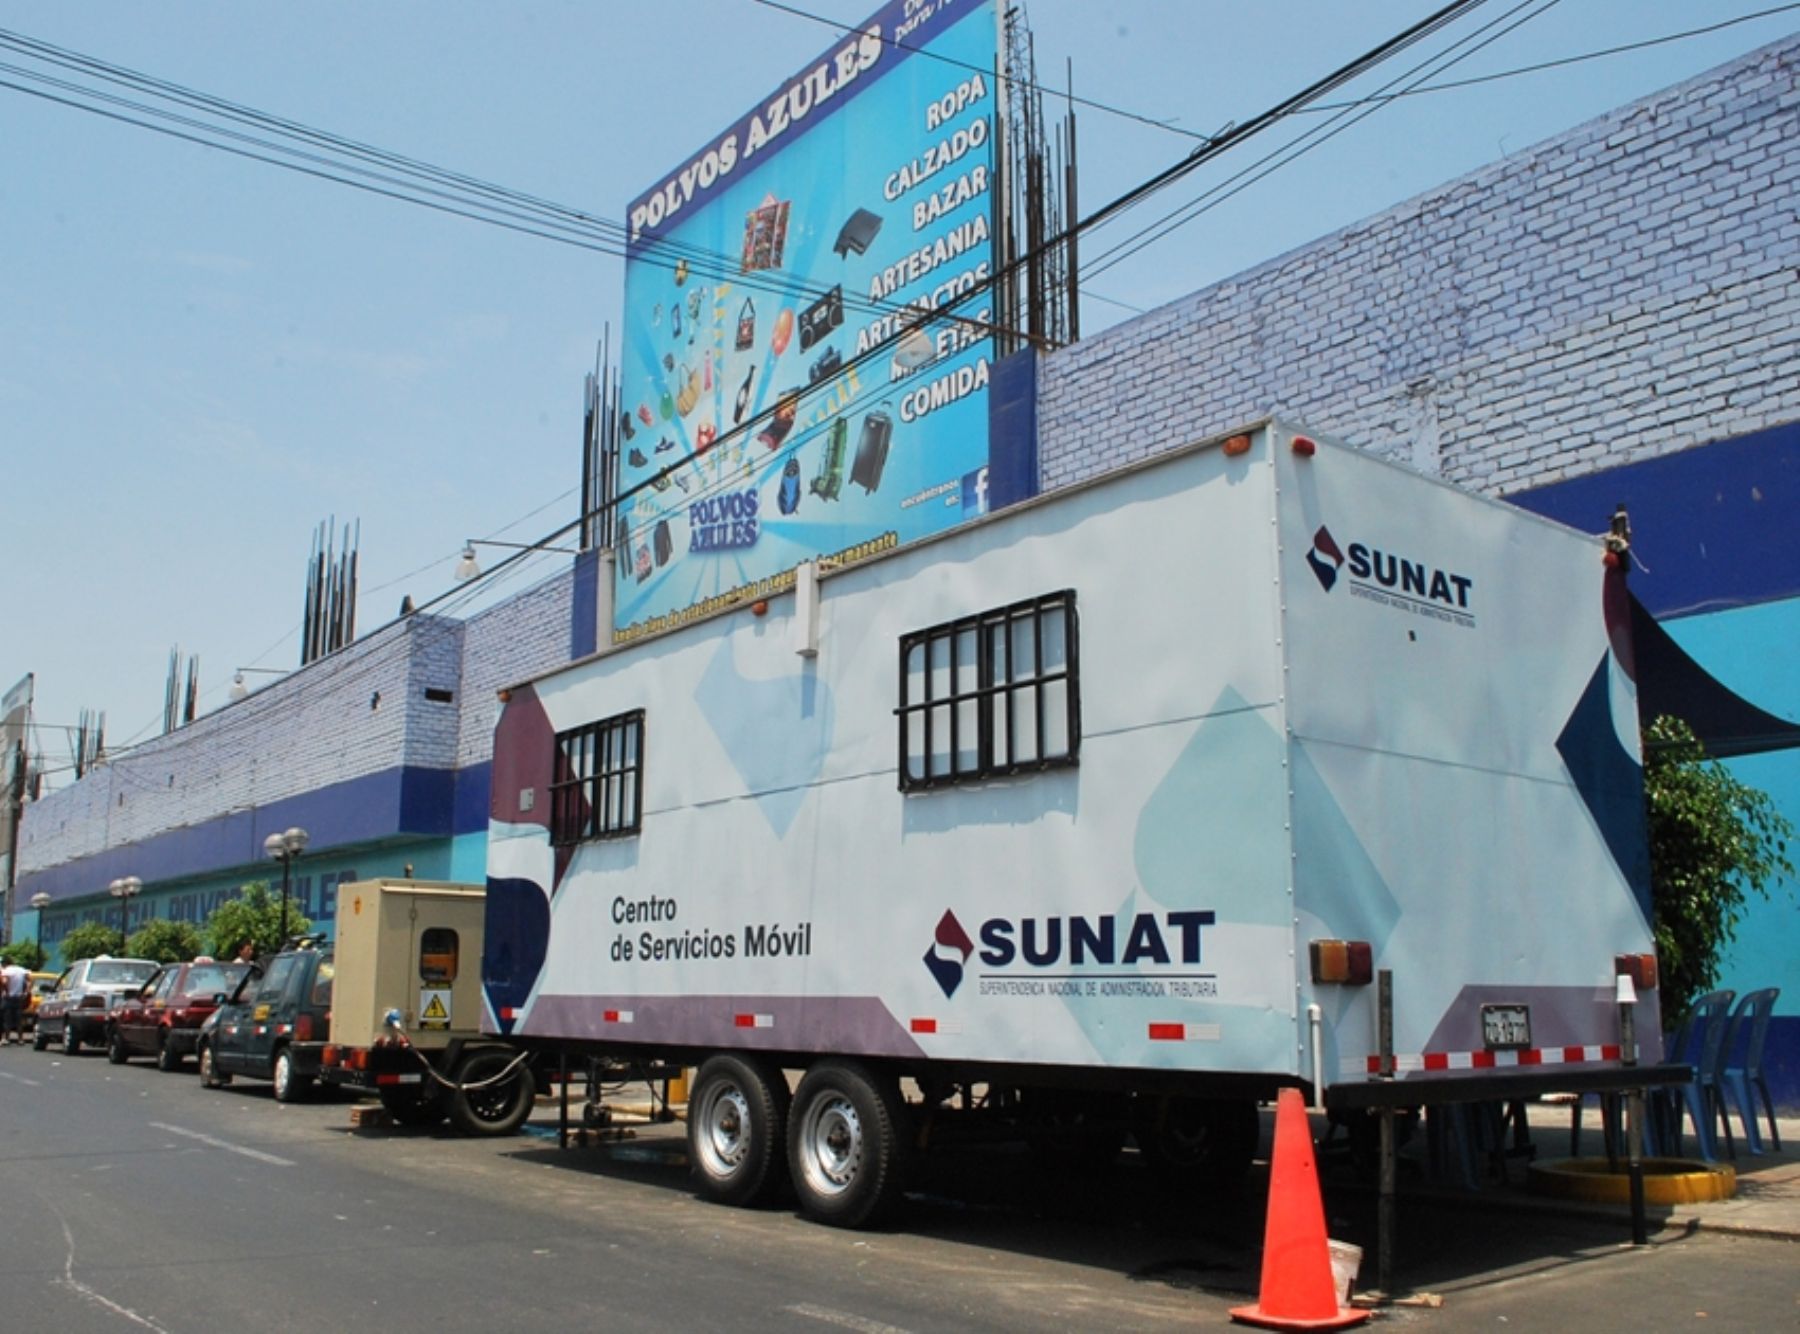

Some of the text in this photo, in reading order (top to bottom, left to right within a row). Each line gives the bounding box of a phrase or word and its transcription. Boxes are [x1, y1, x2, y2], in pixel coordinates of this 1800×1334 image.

[926, 73, 986, 131] ROPA
[630, 23, 882, 243] POLVOS AZULES
[884, 118, 988, 200] CALZADO
[912, 165, 988, 232] BAZAR
[869, 214, 989, 305] ARTESANIA
[900, 356, 989, 422] COMIDA
[689, 488, 758, 528] POLVOS
[689, 518, 758, 553] AZULES
[1347, 542, 1473, 608] SUNAT
[611, 895, 677, 924] Centro
[978, 910, 1216, 967] SUNAT
[610, 922, 812, 962] de Servicios Móvil
[1047, 981, 1083, 997] NACIONAL
[1085, 981, 1097, 997] DE
[1169, 981, 1218, 998] TRIBUTARIA
